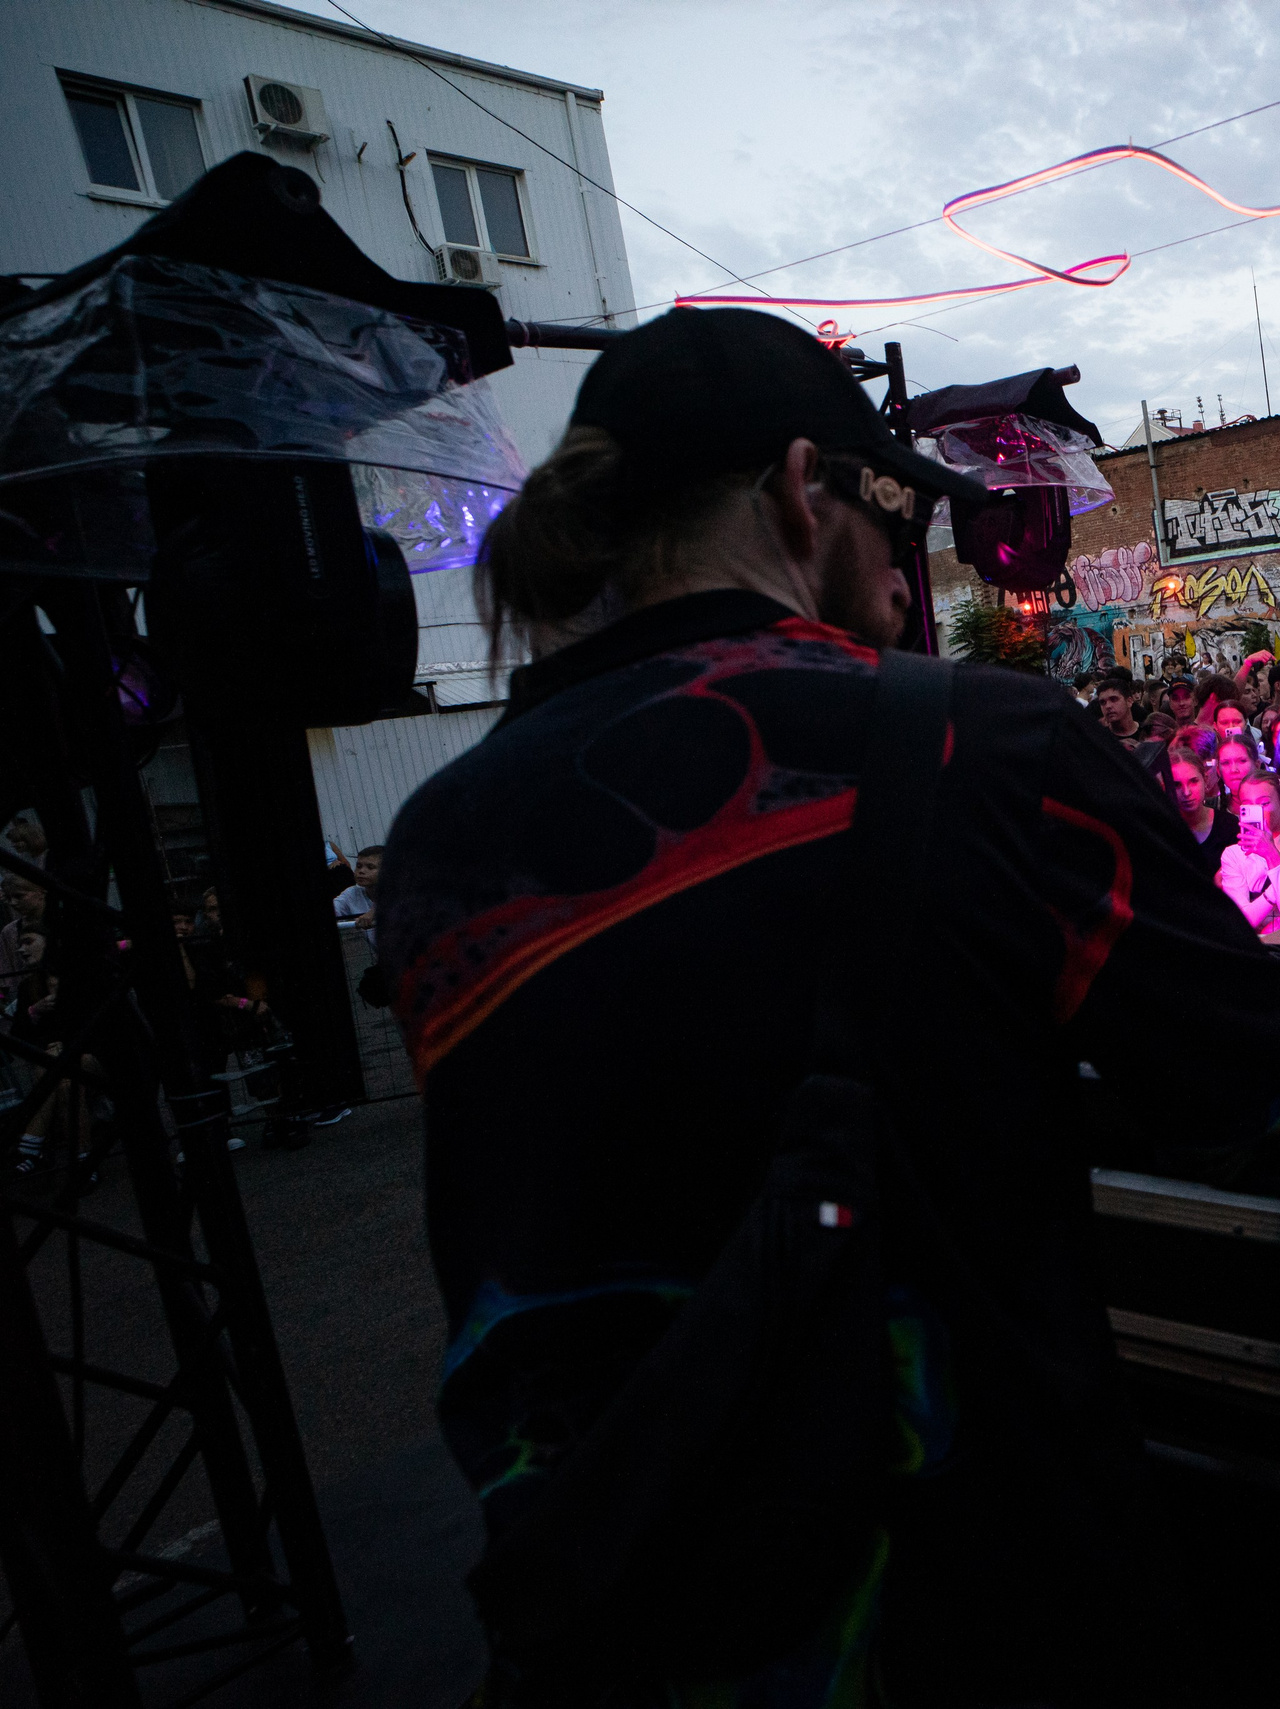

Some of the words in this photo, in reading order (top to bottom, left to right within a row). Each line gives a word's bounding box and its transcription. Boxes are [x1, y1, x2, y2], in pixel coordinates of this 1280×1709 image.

[292, 475, 307, 508] HEAD
[298, 508, 316, 557] MOVING
[308, 558, 321, 580] LED
